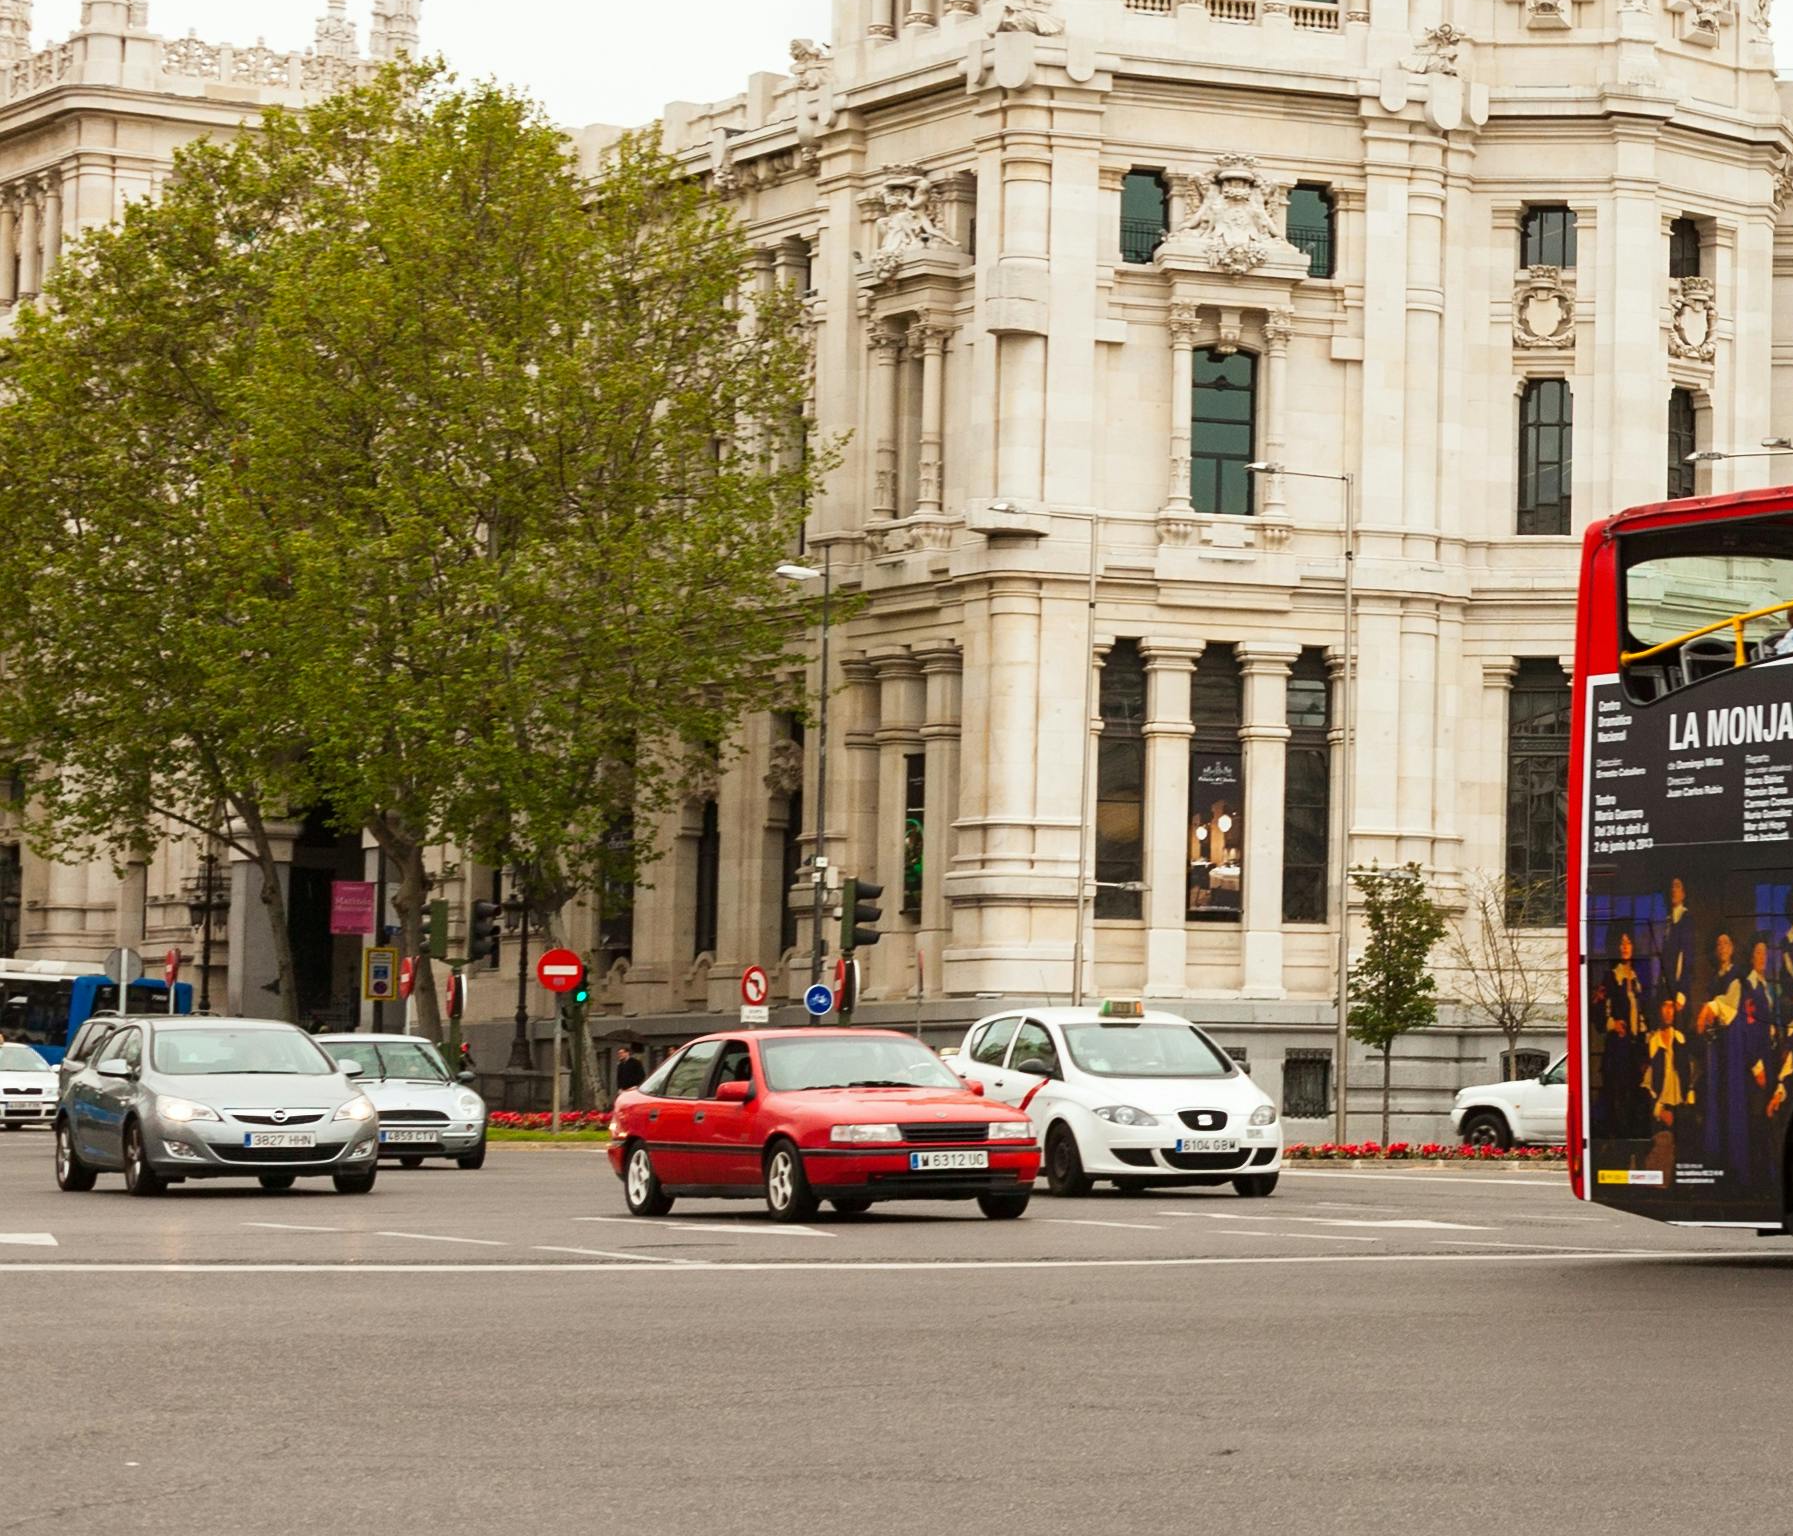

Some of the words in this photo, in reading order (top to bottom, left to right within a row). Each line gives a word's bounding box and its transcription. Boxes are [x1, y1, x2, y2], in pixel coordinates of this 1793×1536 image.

[1669, 711, 1700, 751] LA
[254, 1133, 284, 1146] 3827
[289, 1134, 312, 1146] HHN
[1184, 1140, 1210, 1151] 6104
[933, 1154, 966, 1167] 6312
